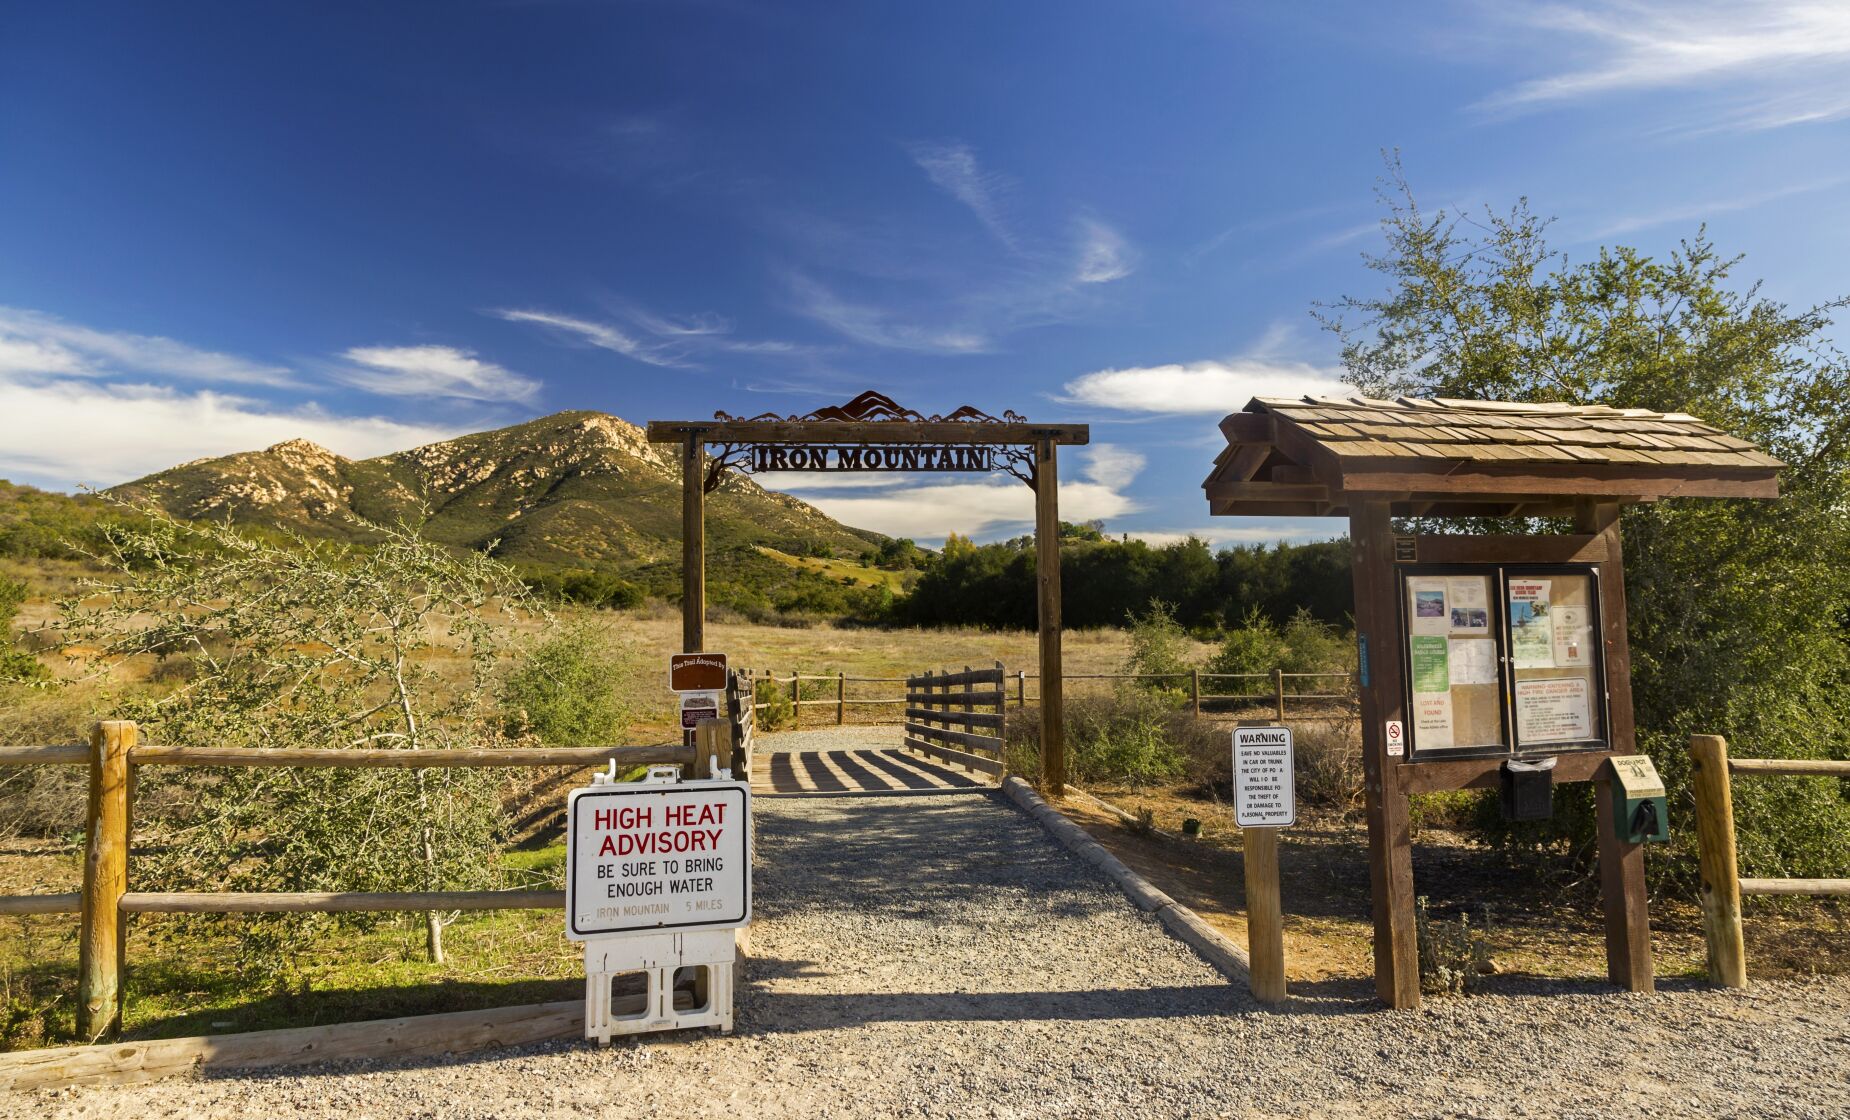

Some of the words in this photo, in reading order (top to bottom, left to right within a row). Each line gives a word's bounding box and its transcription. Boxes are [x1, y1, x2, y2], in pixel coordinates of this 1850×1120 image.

[757, 448, 827, 469] IRON
[837, 448, 985, 469] MOUNTAIN
[672, 662, 684, 671] This
[683, 658, 696, 667] Trail
[696, 658, 718, 667] Adopted
[718, 661, 725, 670] By
[1240, 734, 1286, 743] WARNING
[594, 807, 652, 831] HIGH
[665, 803, 728, 827] HEAT
[598, 828, 724, 857] ADVISORY
[597, 864, 615, 879] BE
[621, 861, 657, 877] SURE
[662, 859, 679, 875] TO
[685, 857, 724, 873] BRING
[607, 880, 663, 899] ENOUGH
[669, 877, 714, 894] WATER
[596, 905, 620, 919] IRON
[623, 902, 670, 917] MOUNTAIN
[685, 901, 692, 912] 5
[695, 899, 723, 911] MILES
